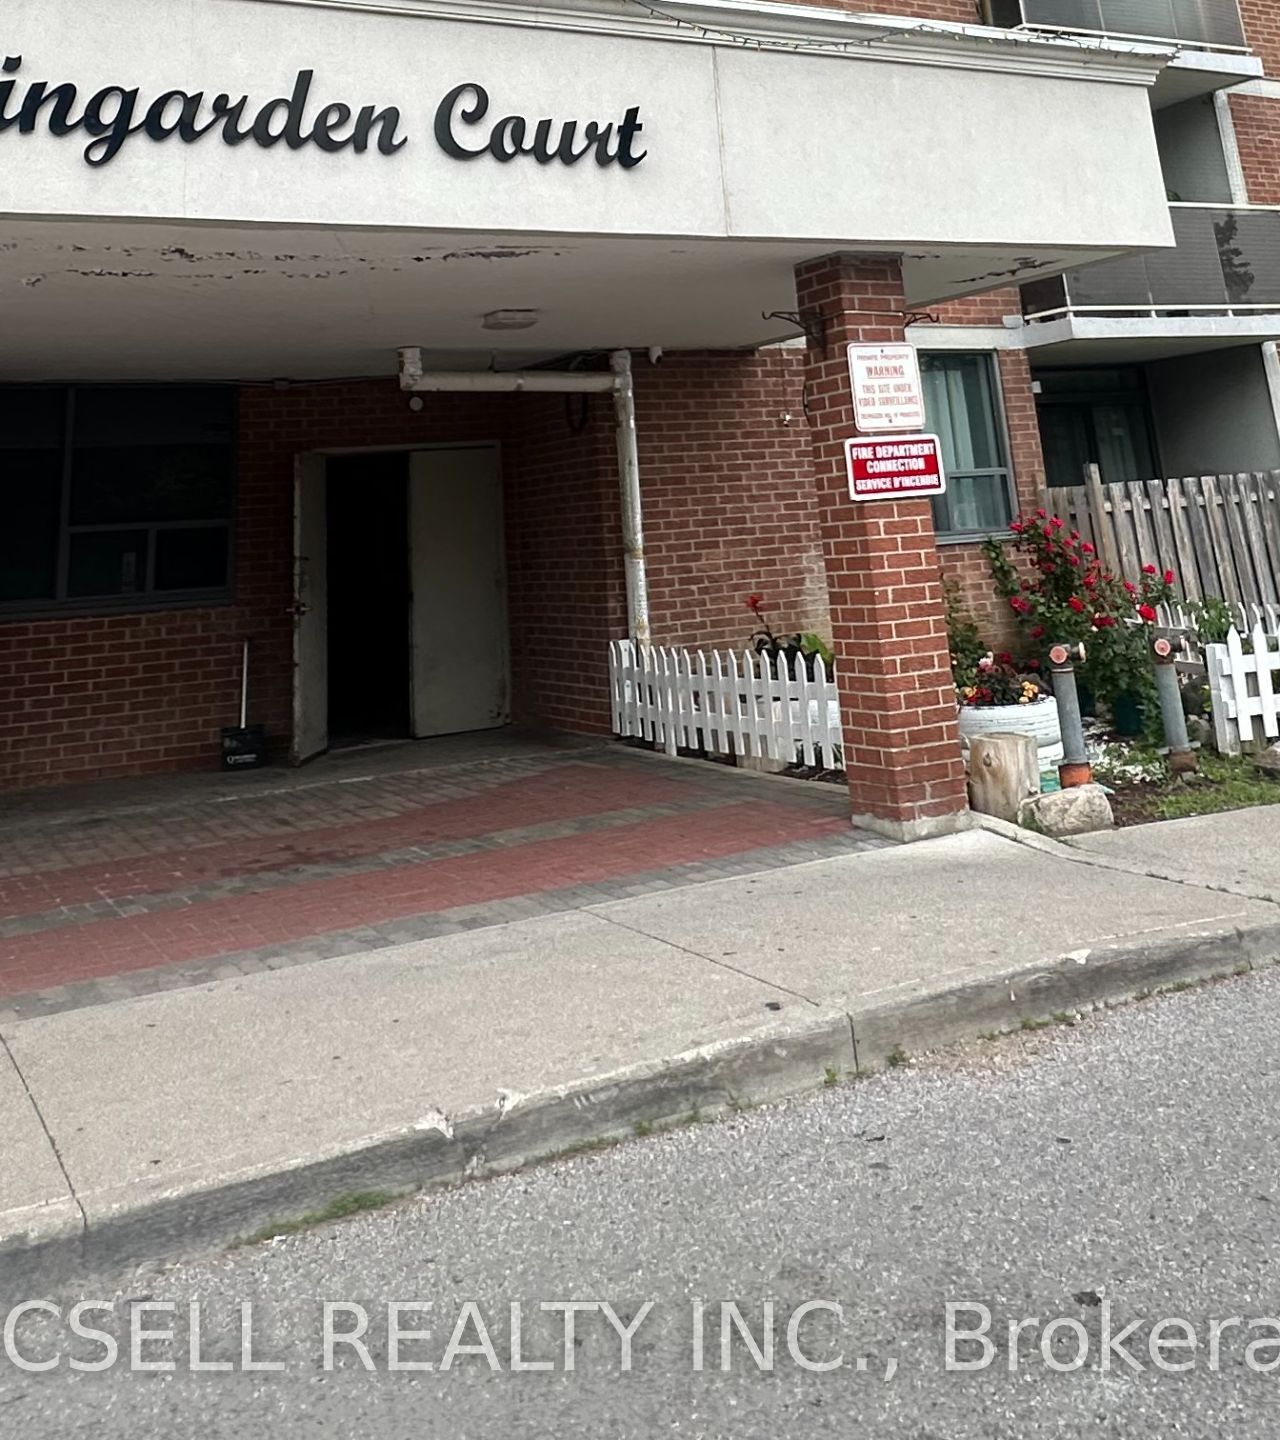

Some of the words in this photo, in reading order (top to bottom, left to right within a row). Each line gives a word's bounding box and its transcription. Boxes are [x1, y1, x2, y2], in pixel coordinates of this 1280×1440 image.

[433, 82, 648, 168] Court
[865, 365, 905, 377] WARNING
[862, 384, 876, 394] THIS
[878, 384, 891, 393] SITE
[852, 447, 875, 460] FIRE
[875, 443, 935, 458] DEPARTMENT
[866, 457, 926, 474] CONNECTION
[855, 477, 893, 491] SERVICE
[893, 474, 939, 488] D'INCENDIE
